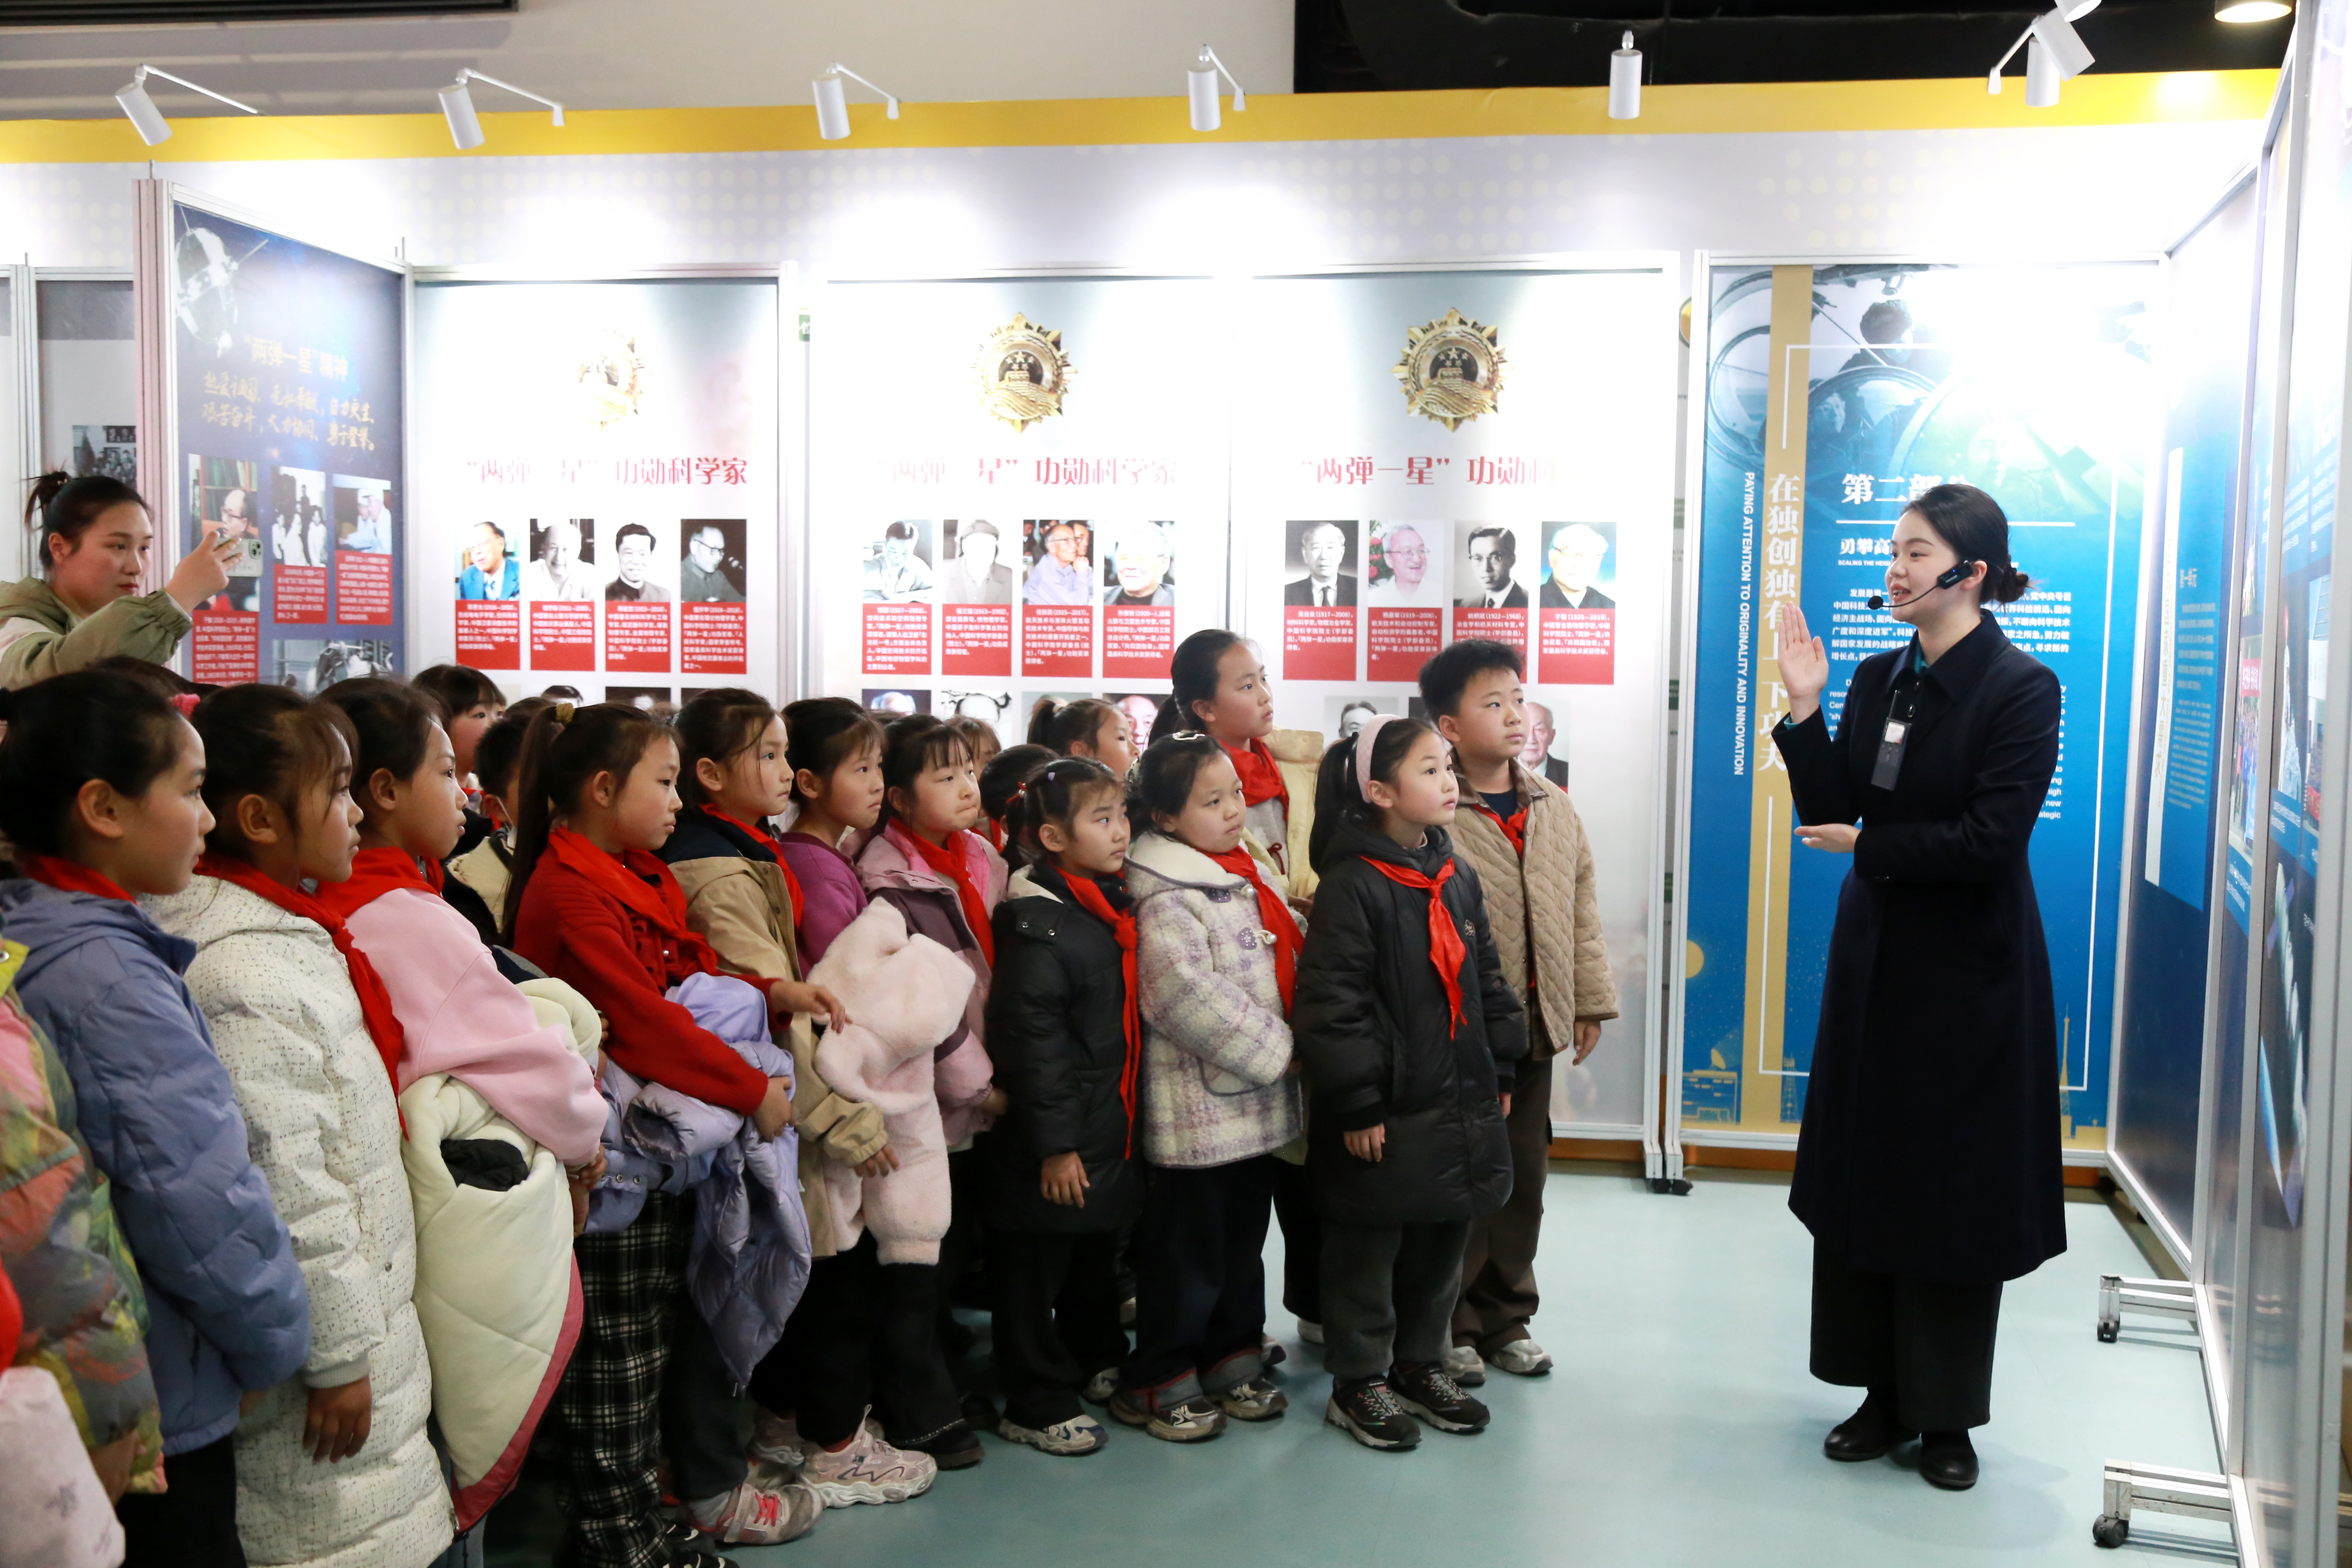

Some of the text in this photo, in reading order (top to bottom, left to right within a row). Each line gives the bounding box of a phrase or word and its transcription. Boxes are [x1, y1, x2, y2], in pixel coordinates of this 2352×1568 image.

[878, 457, 1177, 485] “两弹星” 功勋科学家
[1301, 456, 1586, 485] “两弹一星” 功勋科
[1842, 474, 1975, 505] 第二部
[1734, 472, 1755, 775] PAYING ATTENTION TO ORIGINALITY AND INNOVATION
[1832, 626, 1917, 637] 广度和深度进军”。科技
[2012, 643, 2069, 653] 高点，寻求新的
